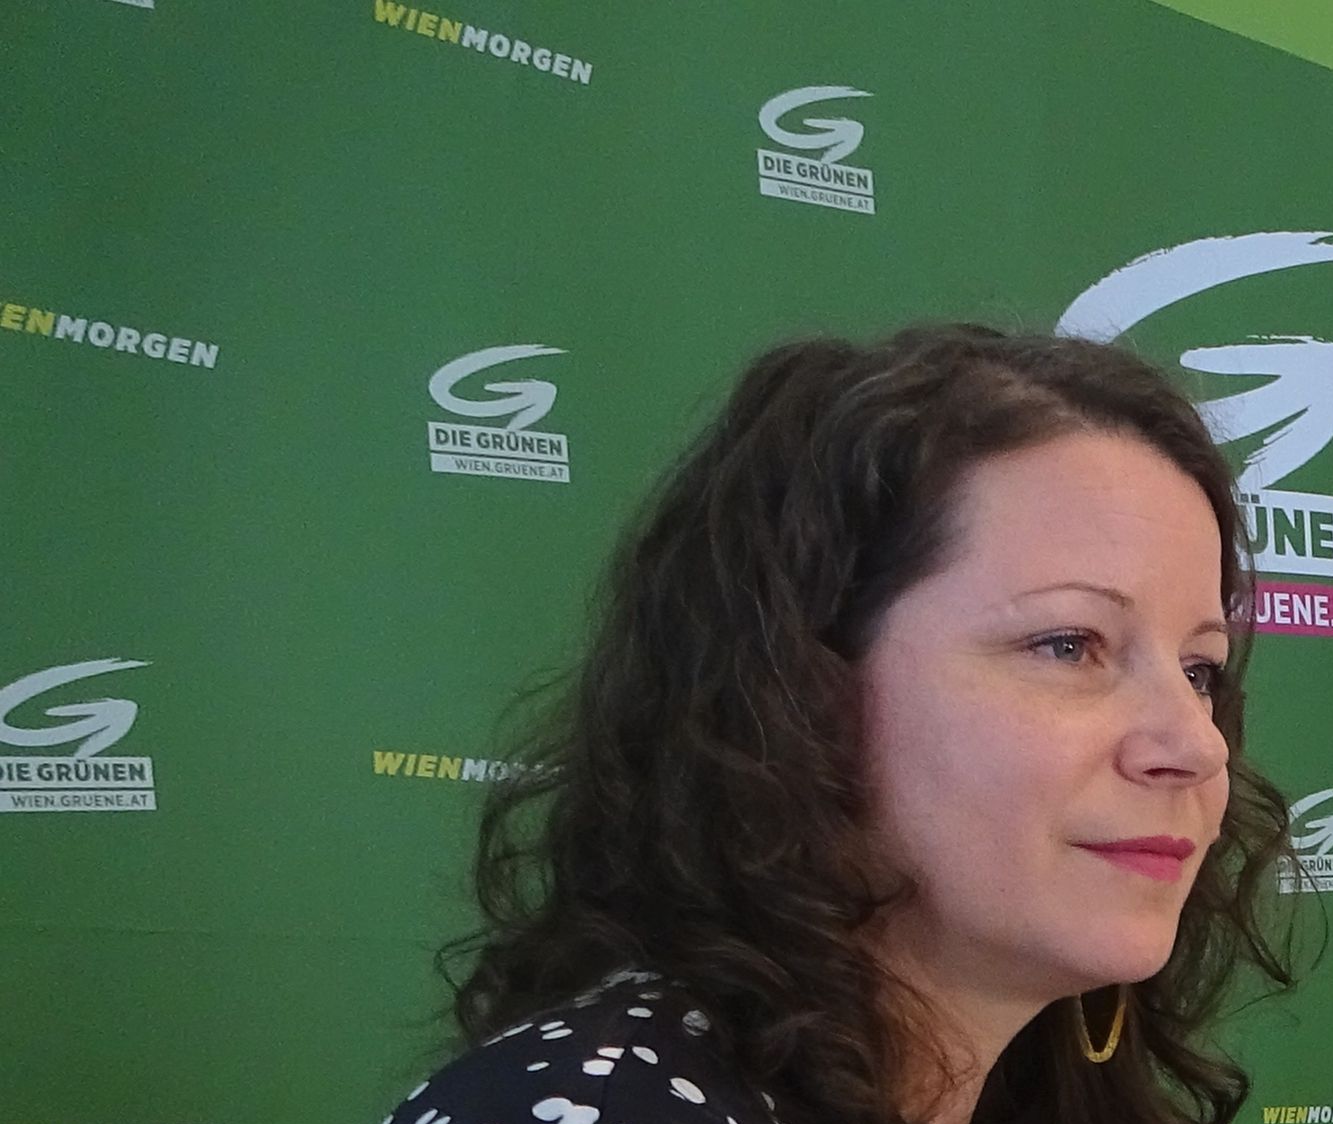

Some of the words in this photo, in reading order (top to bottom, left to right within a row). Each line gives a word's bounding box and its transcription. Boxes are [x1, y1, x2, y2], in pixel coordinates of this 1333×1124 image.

[375, 0, 592, 84] WIENMORGEN
[763, 156, 792, 175] DIE
[797, 162, 868, 189] GRÜNEN
[0, 303, 219, 368] ENMORGEN
[435, 428, 471, 447] DIE
[476, 432, 562, 456] GRÜNEN
[453, 457, 564, 478] WIEN.GRUENE.AT
[37, 759, 147, 781] GRÜNEN
[11, 795, 148, 807] WIEN.GRUENE.AT
